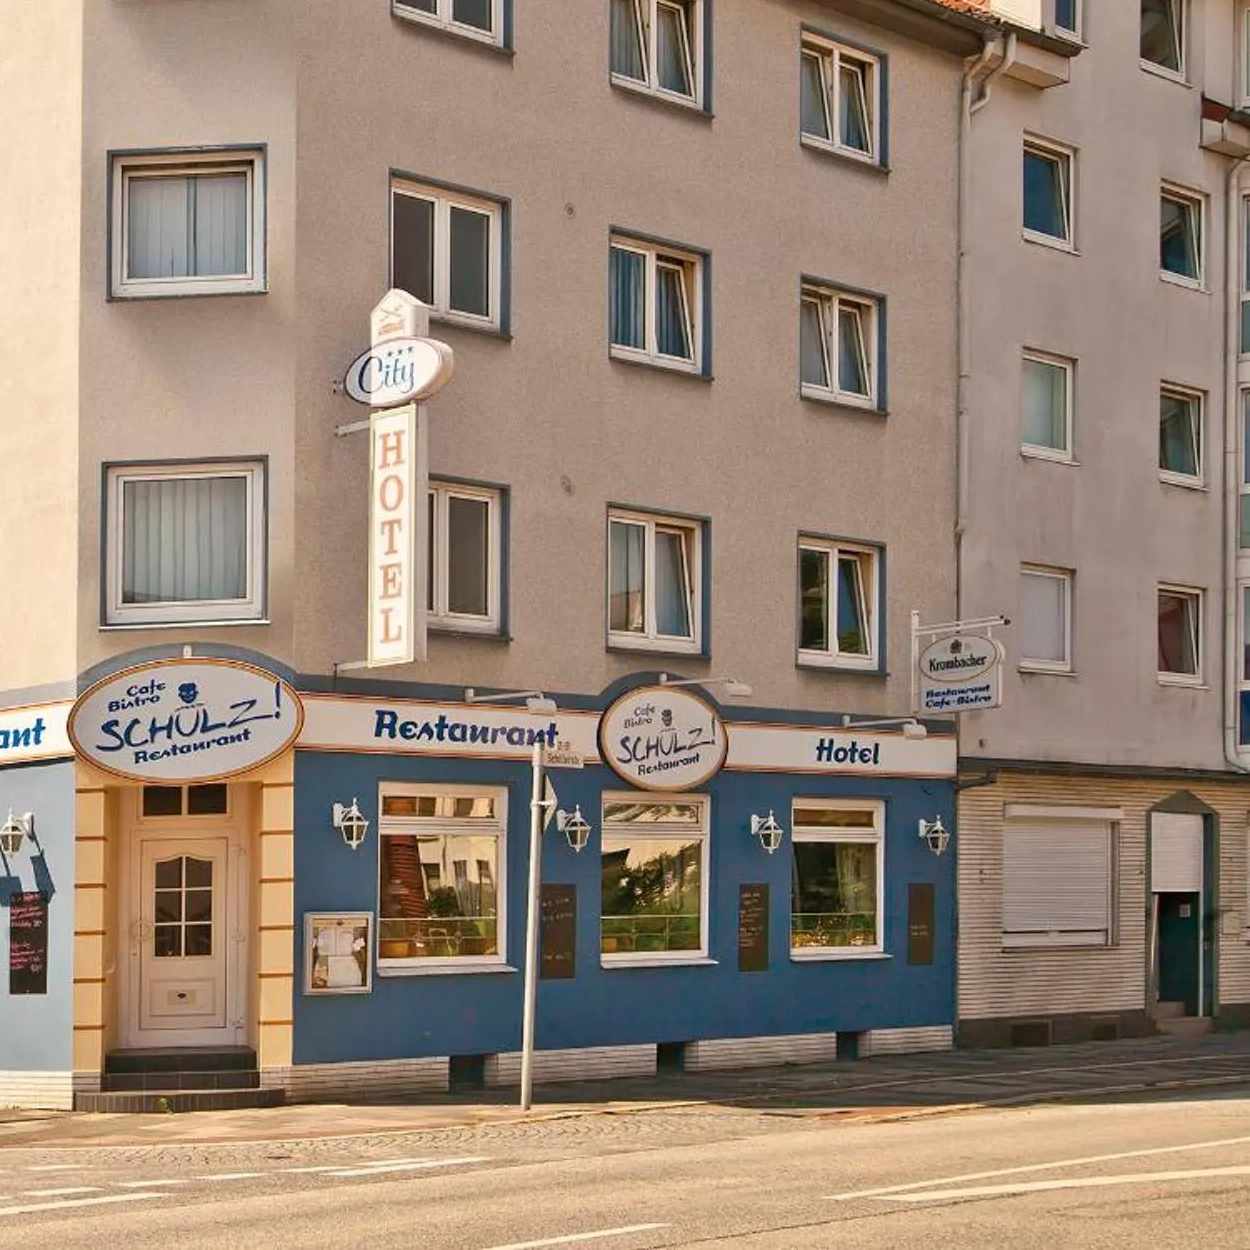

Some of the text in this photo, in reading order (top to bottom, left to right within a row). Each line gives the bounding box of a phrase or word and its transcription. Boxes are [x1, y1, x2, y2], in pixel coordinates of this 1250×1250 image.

[358, 356, 414, 394] City
[378, 429, 406, 645] HOTEL
[929, 654, 988, 672] Krombacher
[108, 693, 161, 713] Bistro
[926, 684, 990, 699] Restaurant
[374, 709, 559, 748] Restaurant
[624, 717, 653, 729] Bistro
[134, 728, 252, 764] Restaurant
[816, 738, 880, 765] Hotel
[638, 752, 700, 776] Restaurant
